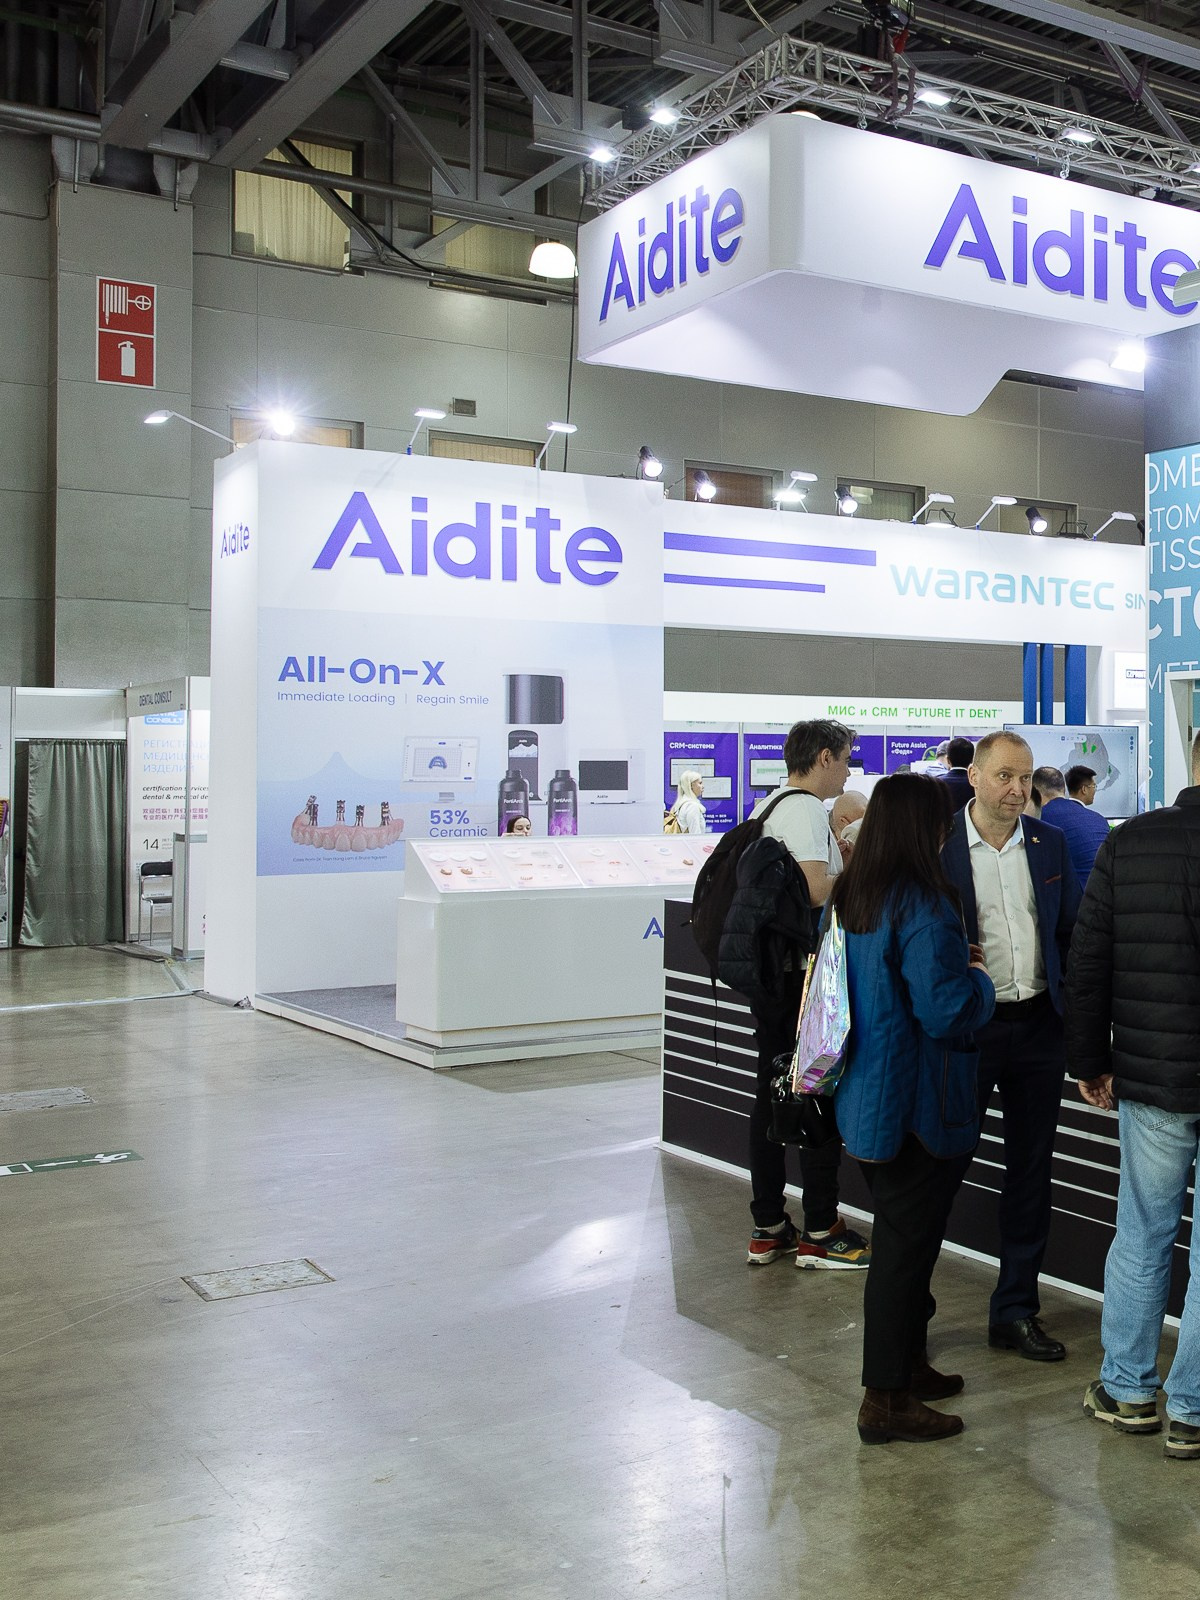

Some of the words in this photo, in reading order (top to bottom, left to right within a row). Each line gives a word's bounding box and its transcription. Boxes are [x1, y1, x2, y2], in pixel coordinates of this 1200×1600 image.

[599, 184, 744, 322] Aidite
[923, 183, 1200, 316] Aidite
[220, 522, 250, 560] Aidite
[311, 490, 624, 587] Aidite
[277, 655, 446, 686] All-On-X
[277, 691, 345, 702] Immediate
[348, 692, 395, 705] Loading
[416, 693, 456, 706] Regain
[459, 695, 489, 705] Smile
[828, 705, 854, 716] МИС
[872, 706, 898, 717] CRM
[955, 708, 965, 718] IT
[669, 742, 715, 750] CRM-система
[173, 793, 198, 801] medcal
[430, 809, 470, 825] 53%
[429, 825, 488, 838] Ceramic
[143, 839, 159, 850] 14
